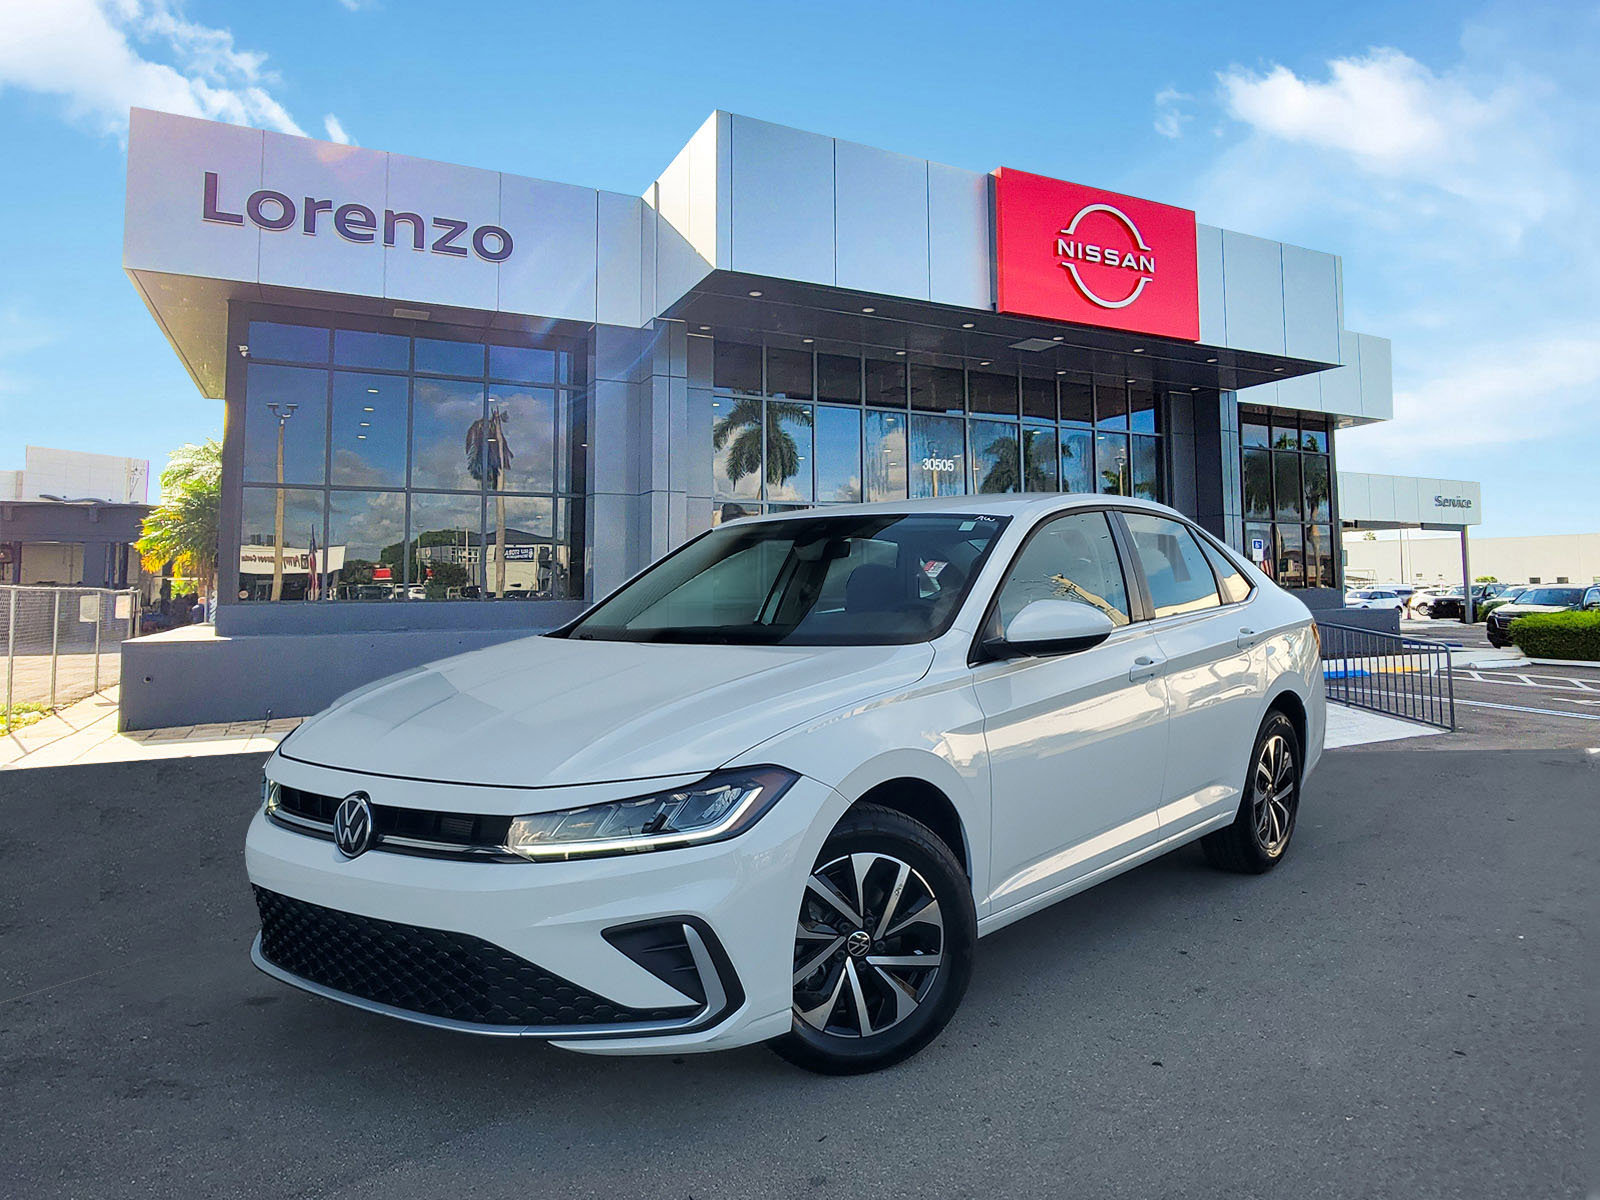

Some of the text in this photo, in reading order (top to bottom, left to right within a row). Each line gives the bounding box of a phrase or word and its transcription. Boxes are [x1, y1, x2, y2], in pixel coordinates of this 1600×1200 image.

[202, 171, 514, 262] Lorenzo
[1057, 238, 1155, 273] NISSAN
[922, 457, 954, 472] 30505
[1434, 495, 1472, 509] Service
